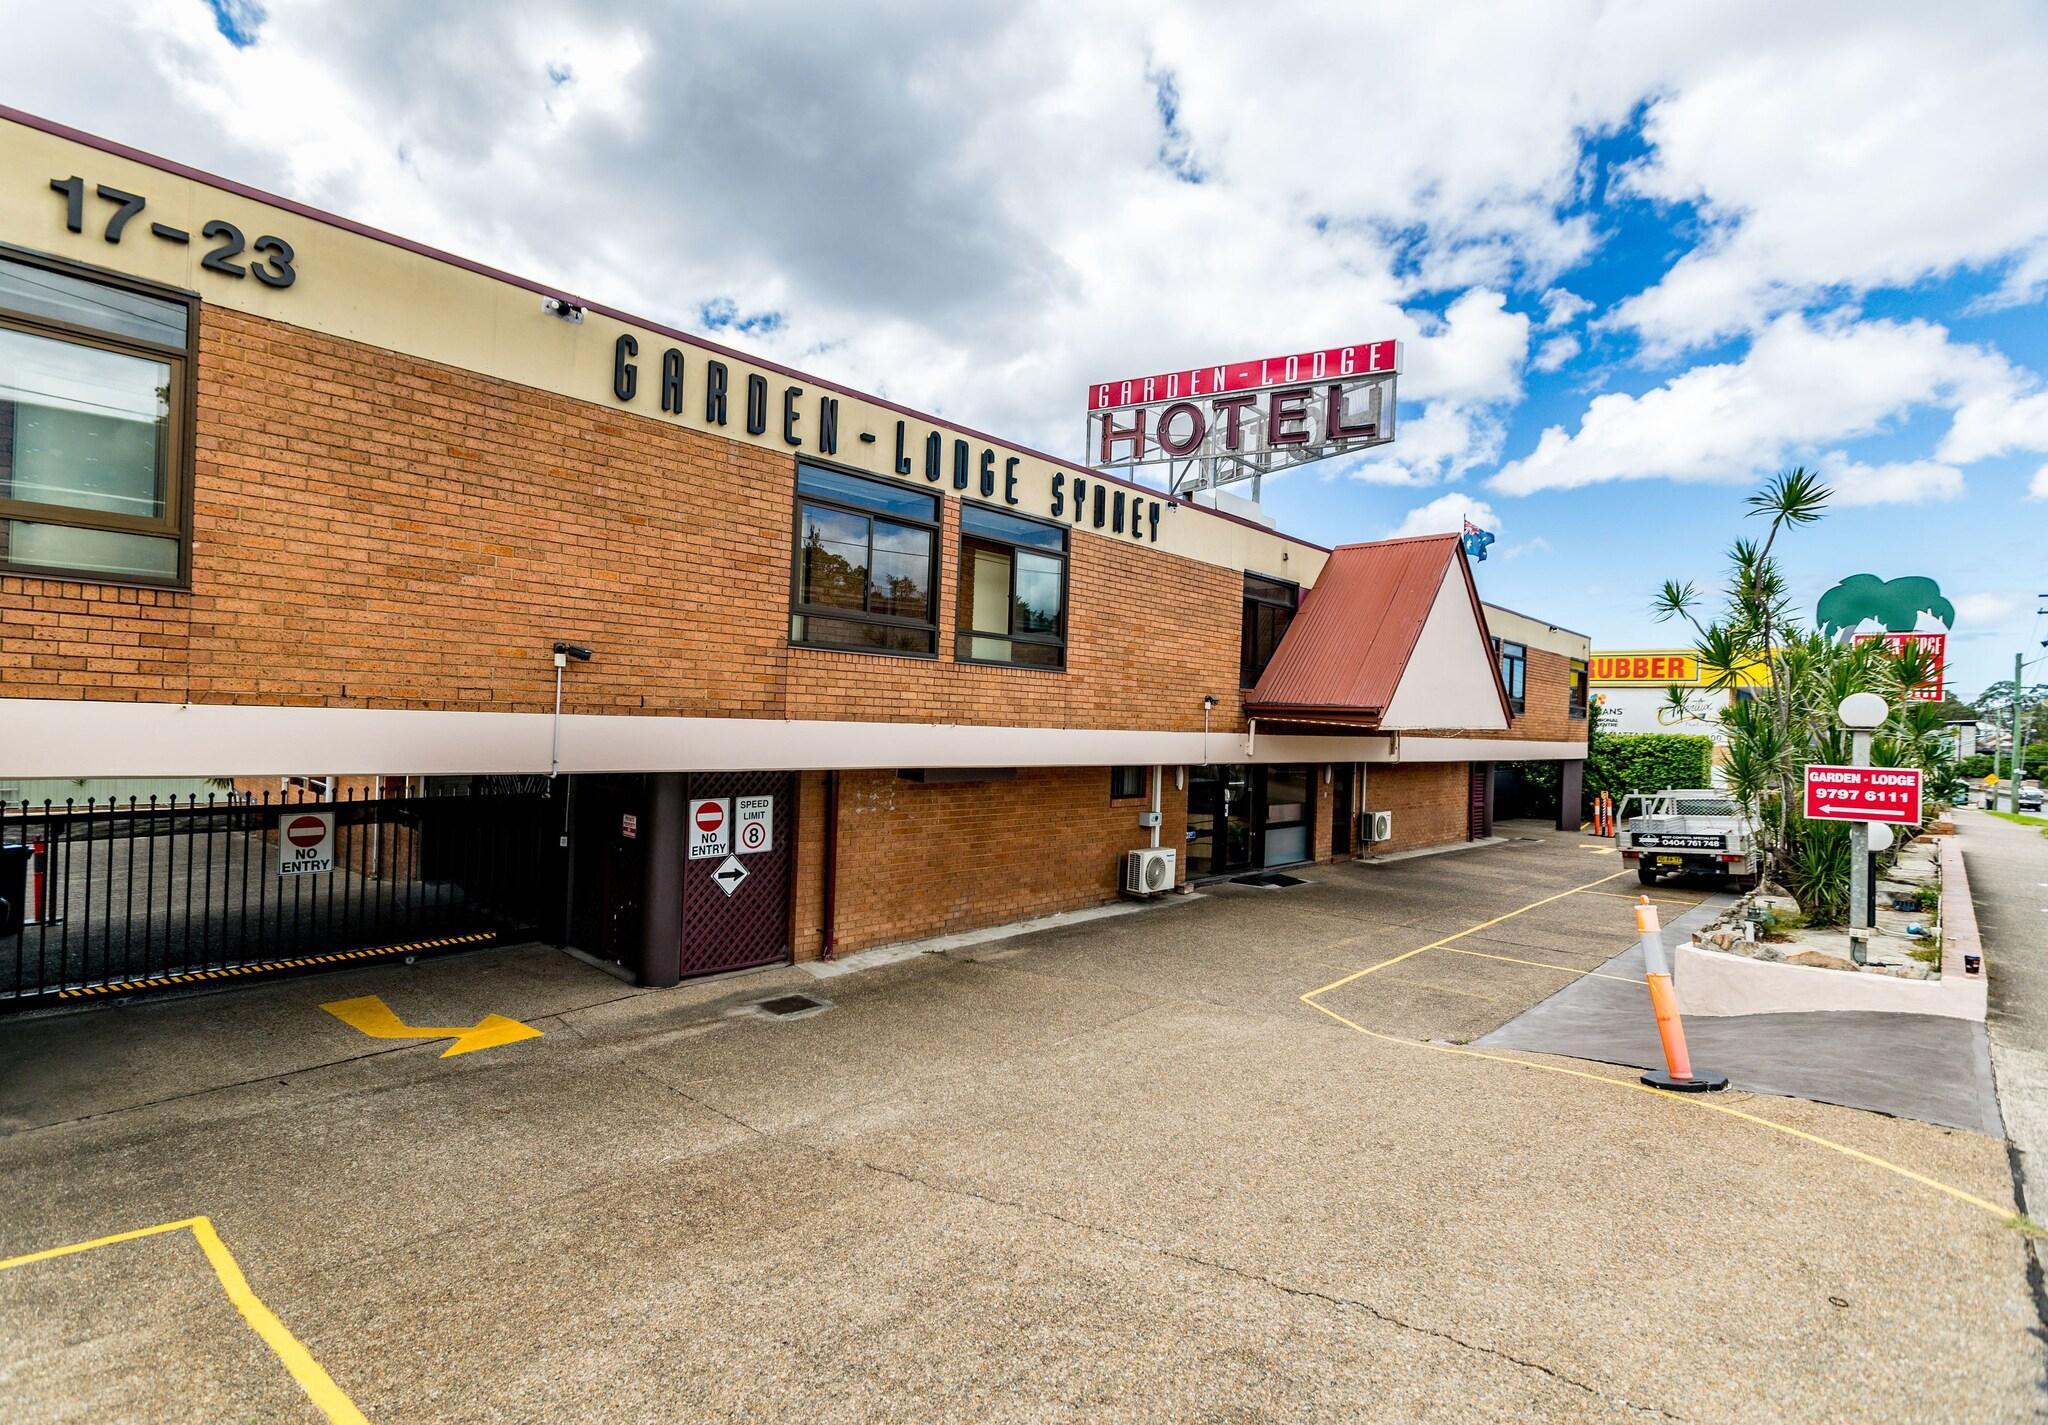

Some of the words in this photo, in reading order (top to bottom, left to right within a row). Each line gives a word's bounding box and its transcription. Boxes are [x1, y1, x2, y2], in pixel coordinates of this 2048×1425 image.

[50, 175, 297, 289] 17-23
[1101, 385, 1376, 464] HOTEL
[1050, 471, 1160, 543] SYDNEY
[1809, 771, 1861, 784] GARDEN
[1871, 774, 1916, 786] LODGE
[1815, 788, 1859, 800] 9797
[1864, 790, 1909, 803] 6111
[740, 799, 769, 809] SPEED
[743, 811, 765, 820] LIMIT
[701, 832, 718, 843] NO
[749, 828, 759, 843] 8
[295, 848, 317, 860] NO
[691, 843, 726, 857] ENTRY
[281, 859, 330, 873] ENTRY
